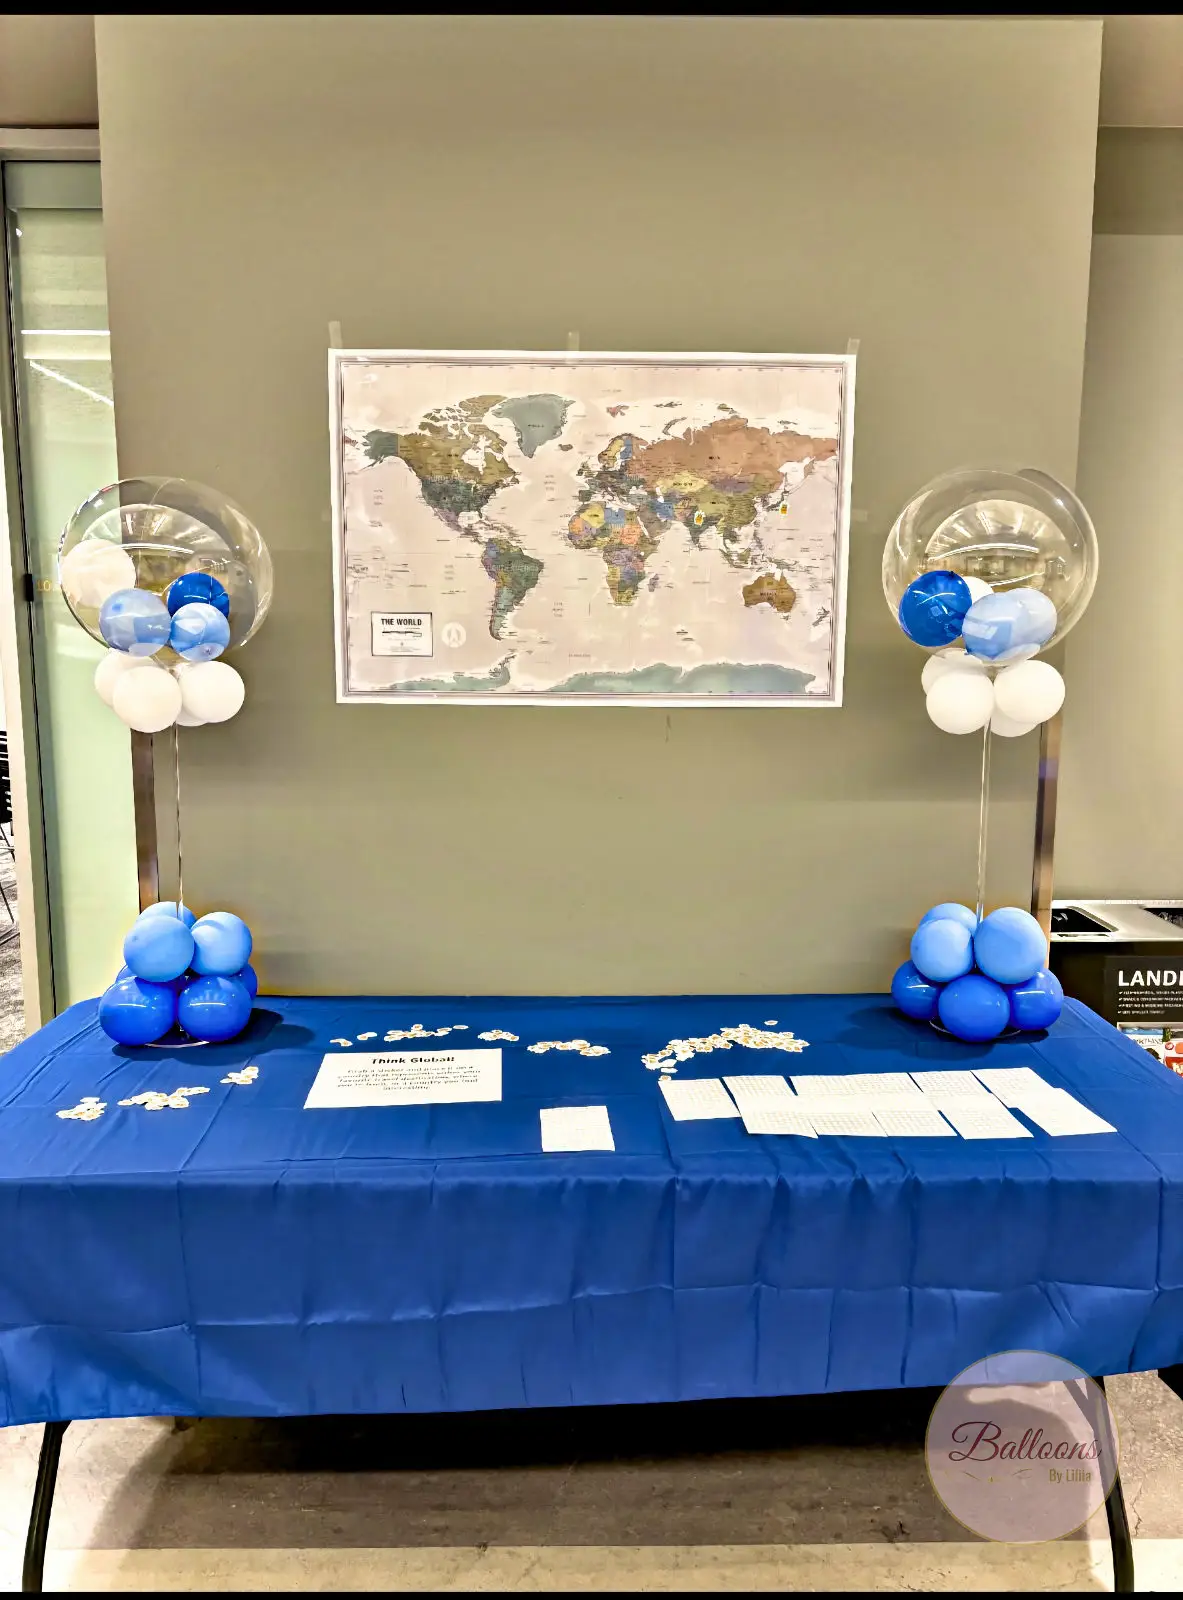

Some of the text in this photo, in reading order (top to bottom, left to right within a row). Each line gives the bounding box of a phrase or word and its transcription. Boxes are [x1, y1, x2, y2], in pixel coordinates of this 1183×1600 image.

[381, 618, 422, 626] THE WORLD
[372, 1057, 406, 1065] Think
